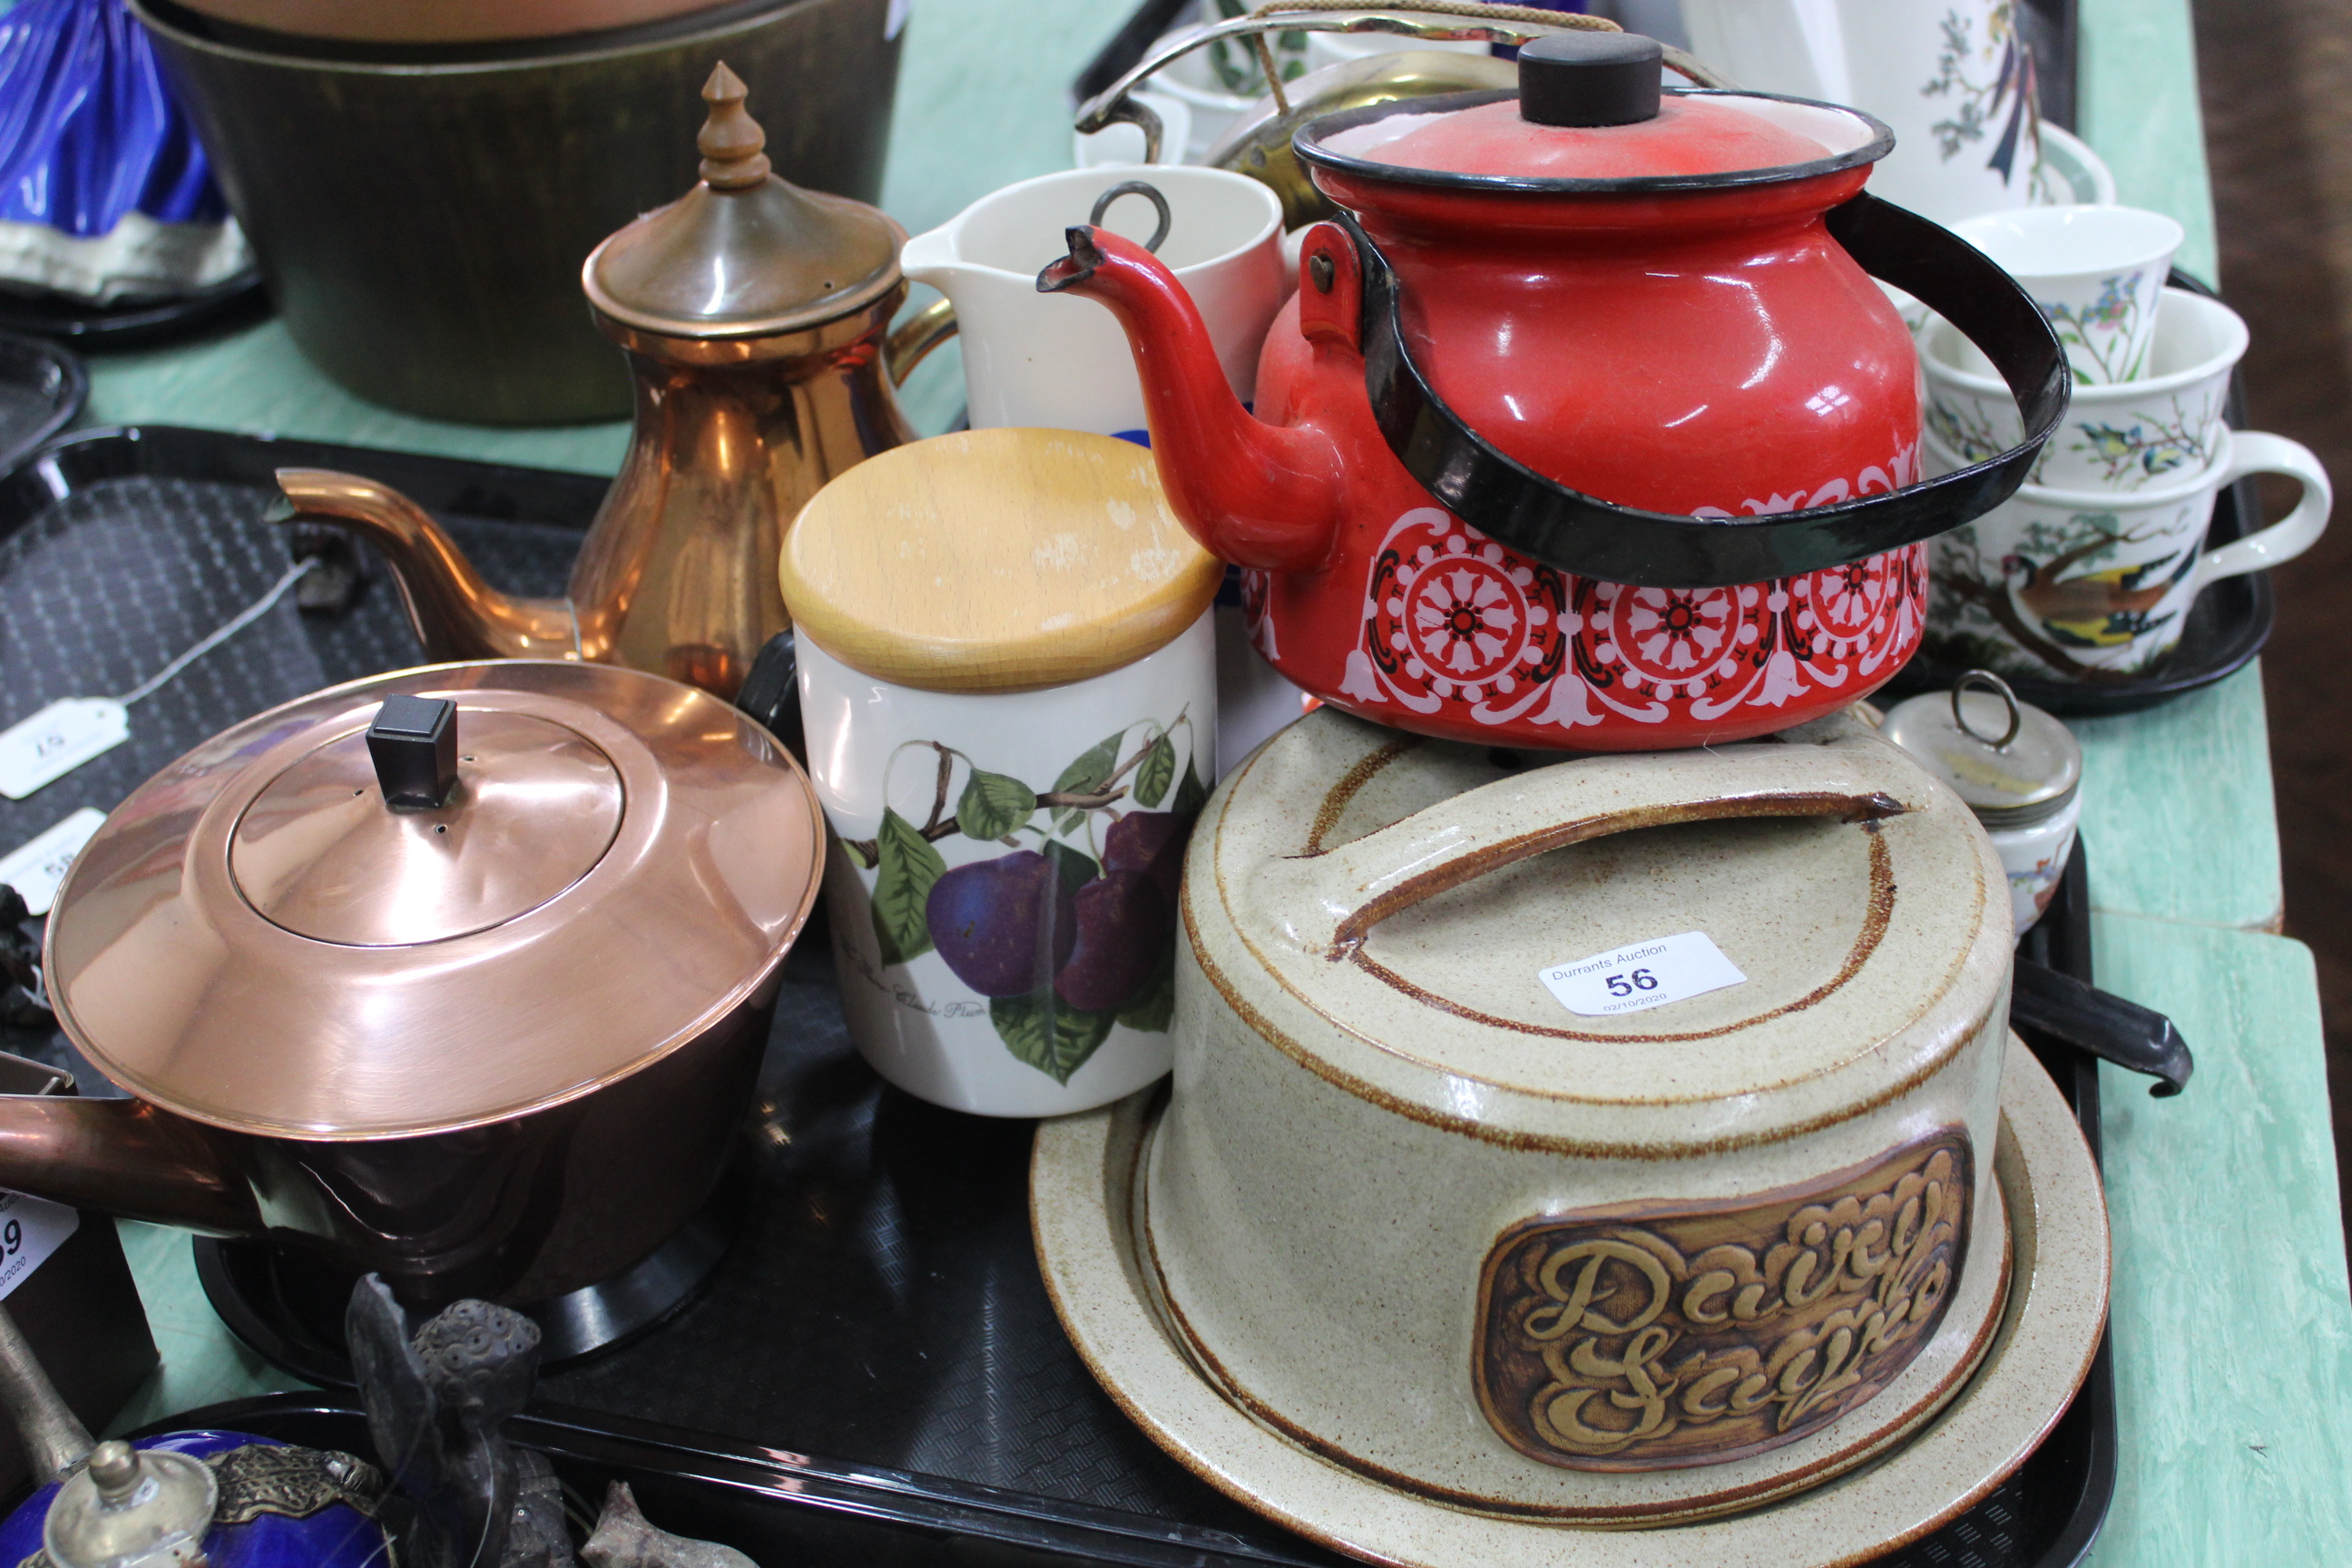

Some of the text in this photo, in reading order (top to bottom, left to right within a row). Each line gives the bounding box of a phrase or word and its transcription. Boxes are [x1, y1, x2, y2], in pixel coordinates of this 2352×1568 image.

[1552, 943, 1668, 981] Durrants Auction
[1604, 967, 1659, 997] 56
[943, 1001, 987, 1019] Plum
[1602, 992, 1668, 1013] 02/10/2020
[1524, 1181, 1943, 1340] Dairy
